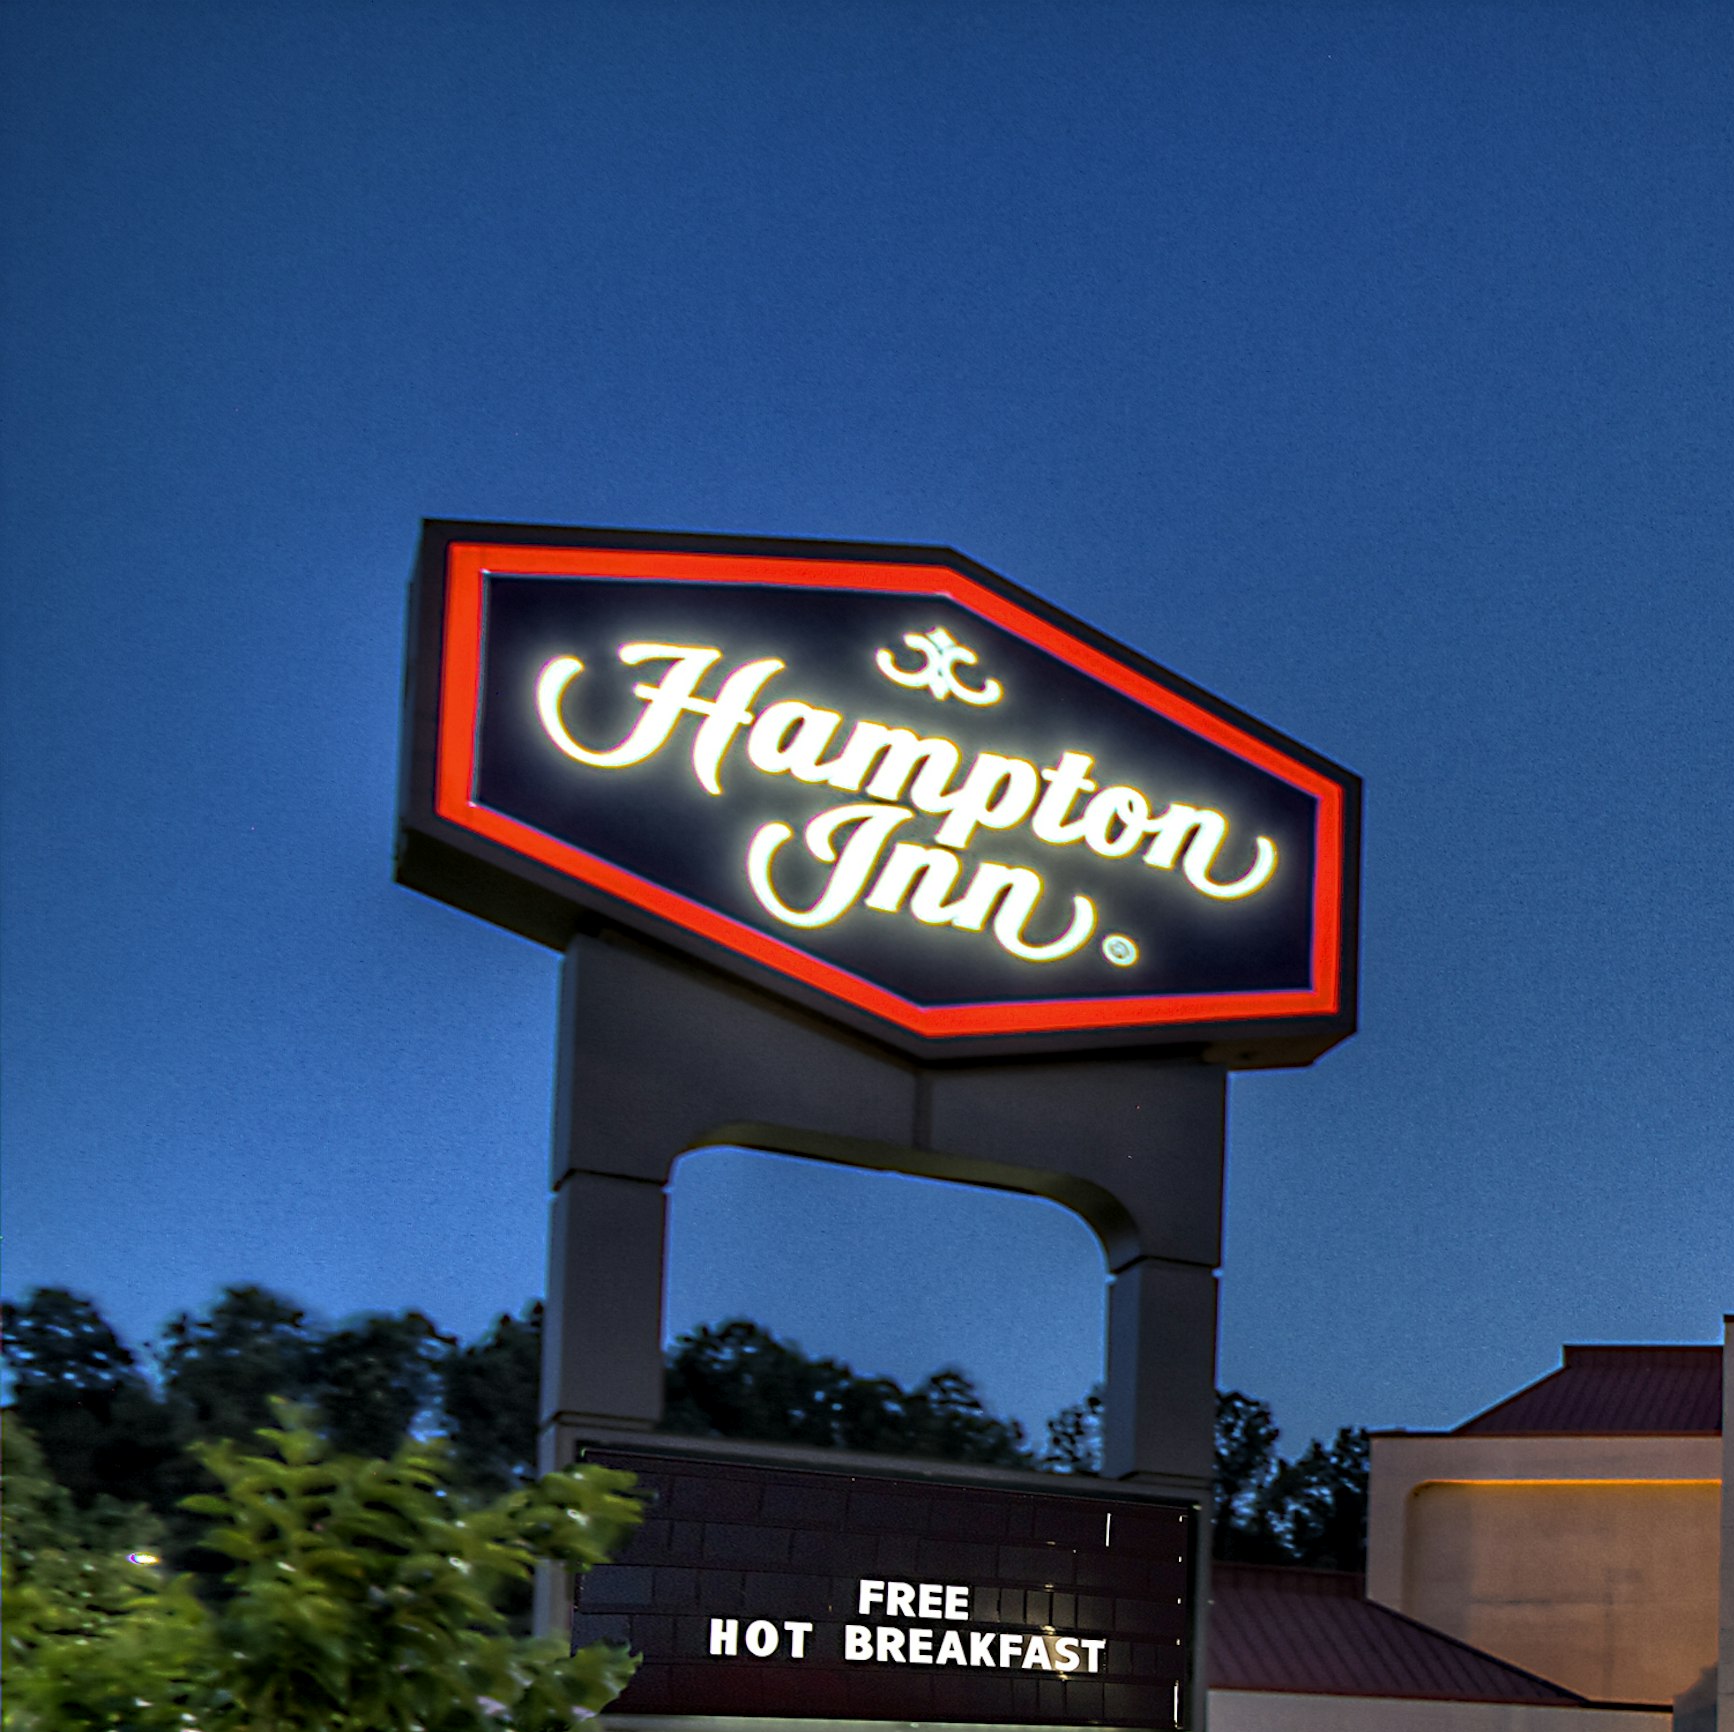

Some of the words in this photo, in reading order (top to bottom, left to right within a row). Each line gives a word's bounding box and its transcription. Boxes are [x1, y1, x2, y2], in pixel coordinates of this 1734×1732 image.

[536, 641, 1276, 899] Hampton
[747, 802, 1095, 962] Inn
[709, 1618, 813, 1659] HOT
[844, 1624, 1107, 1674] BREAKFAST
[858, 1579, 970, 1621] FREE
